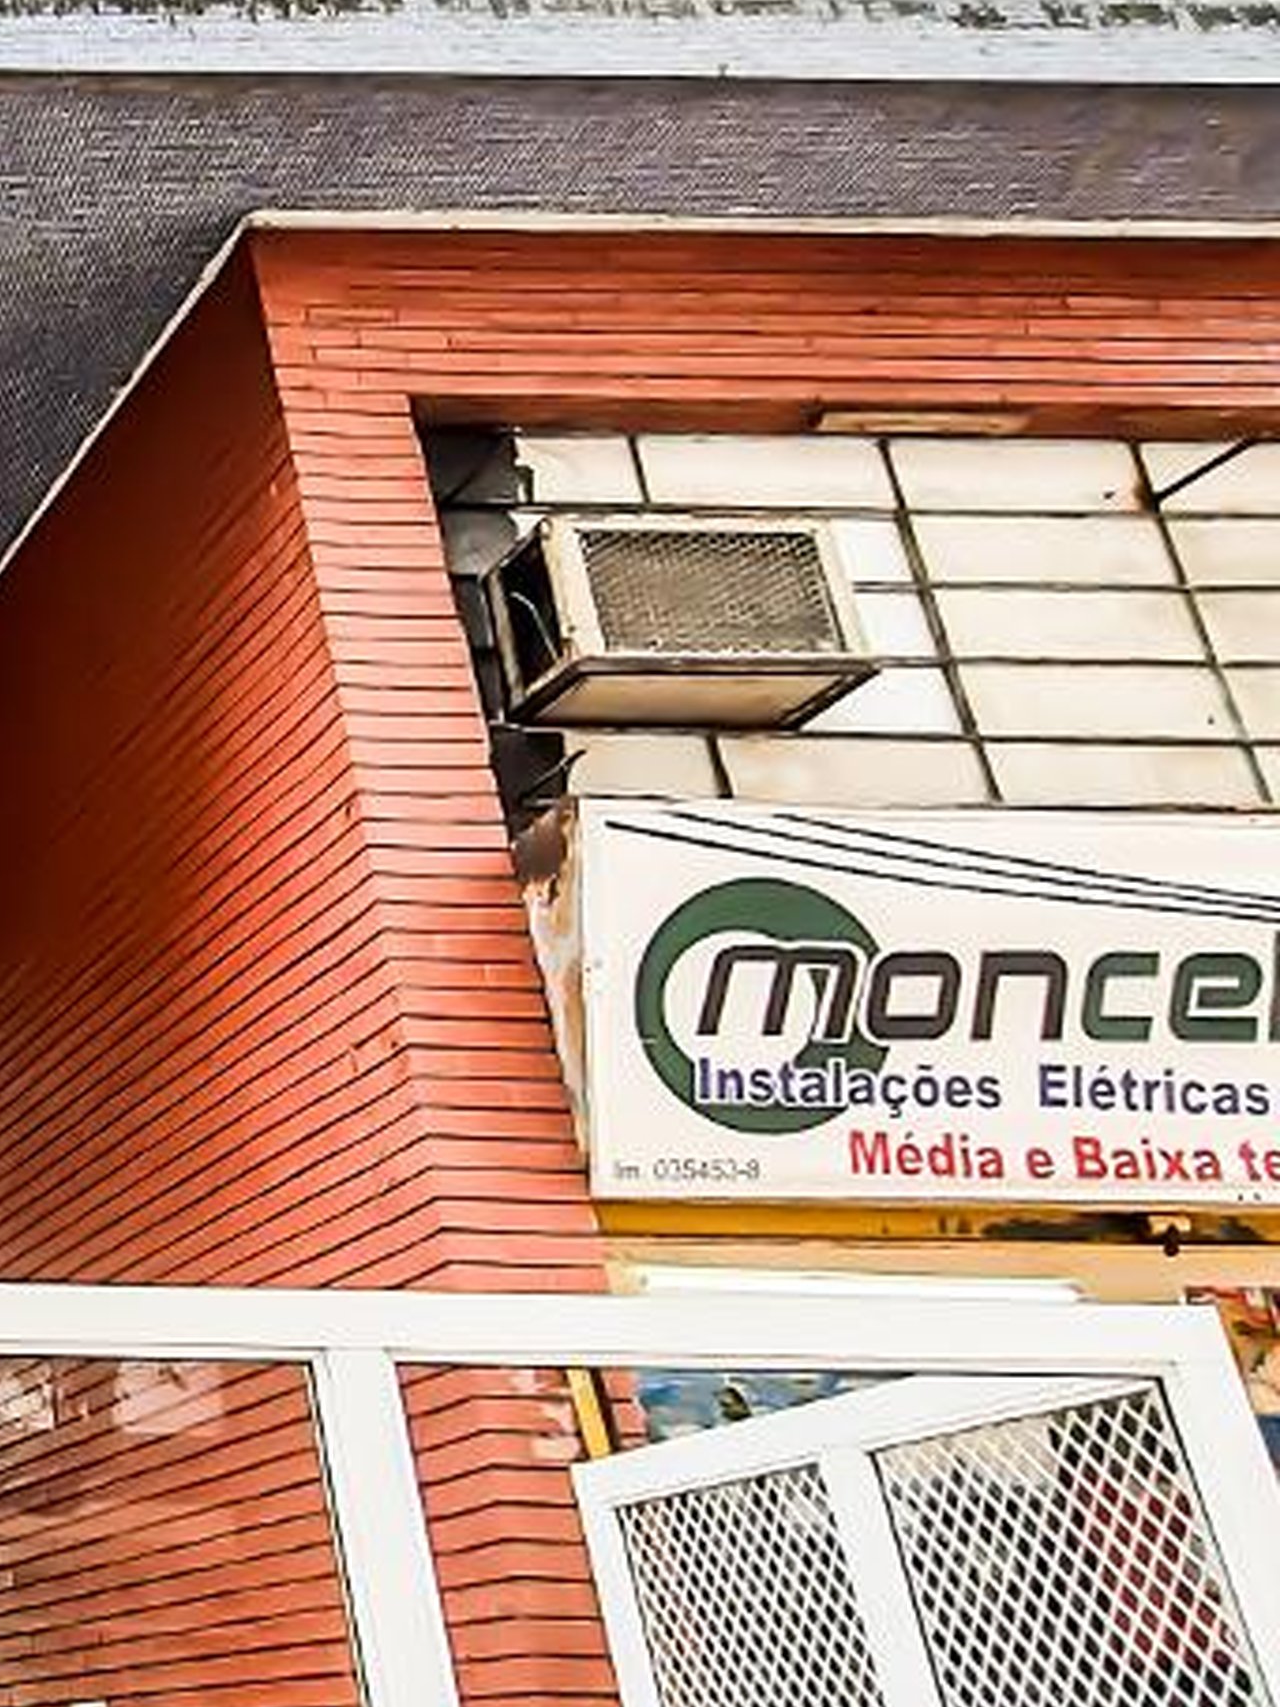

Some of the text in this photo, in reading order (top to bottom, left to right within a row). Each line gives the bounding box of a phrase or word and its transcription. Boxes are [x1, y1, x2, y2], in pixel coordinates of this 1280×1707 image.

[693, 1056, 1271, 1120] Instalações Elétricas
[848, 1128, 1005, 1181] Média
[1025, 1140, 1056, 1180] e
[1073, 1135, 1223, 1183] Baixa
